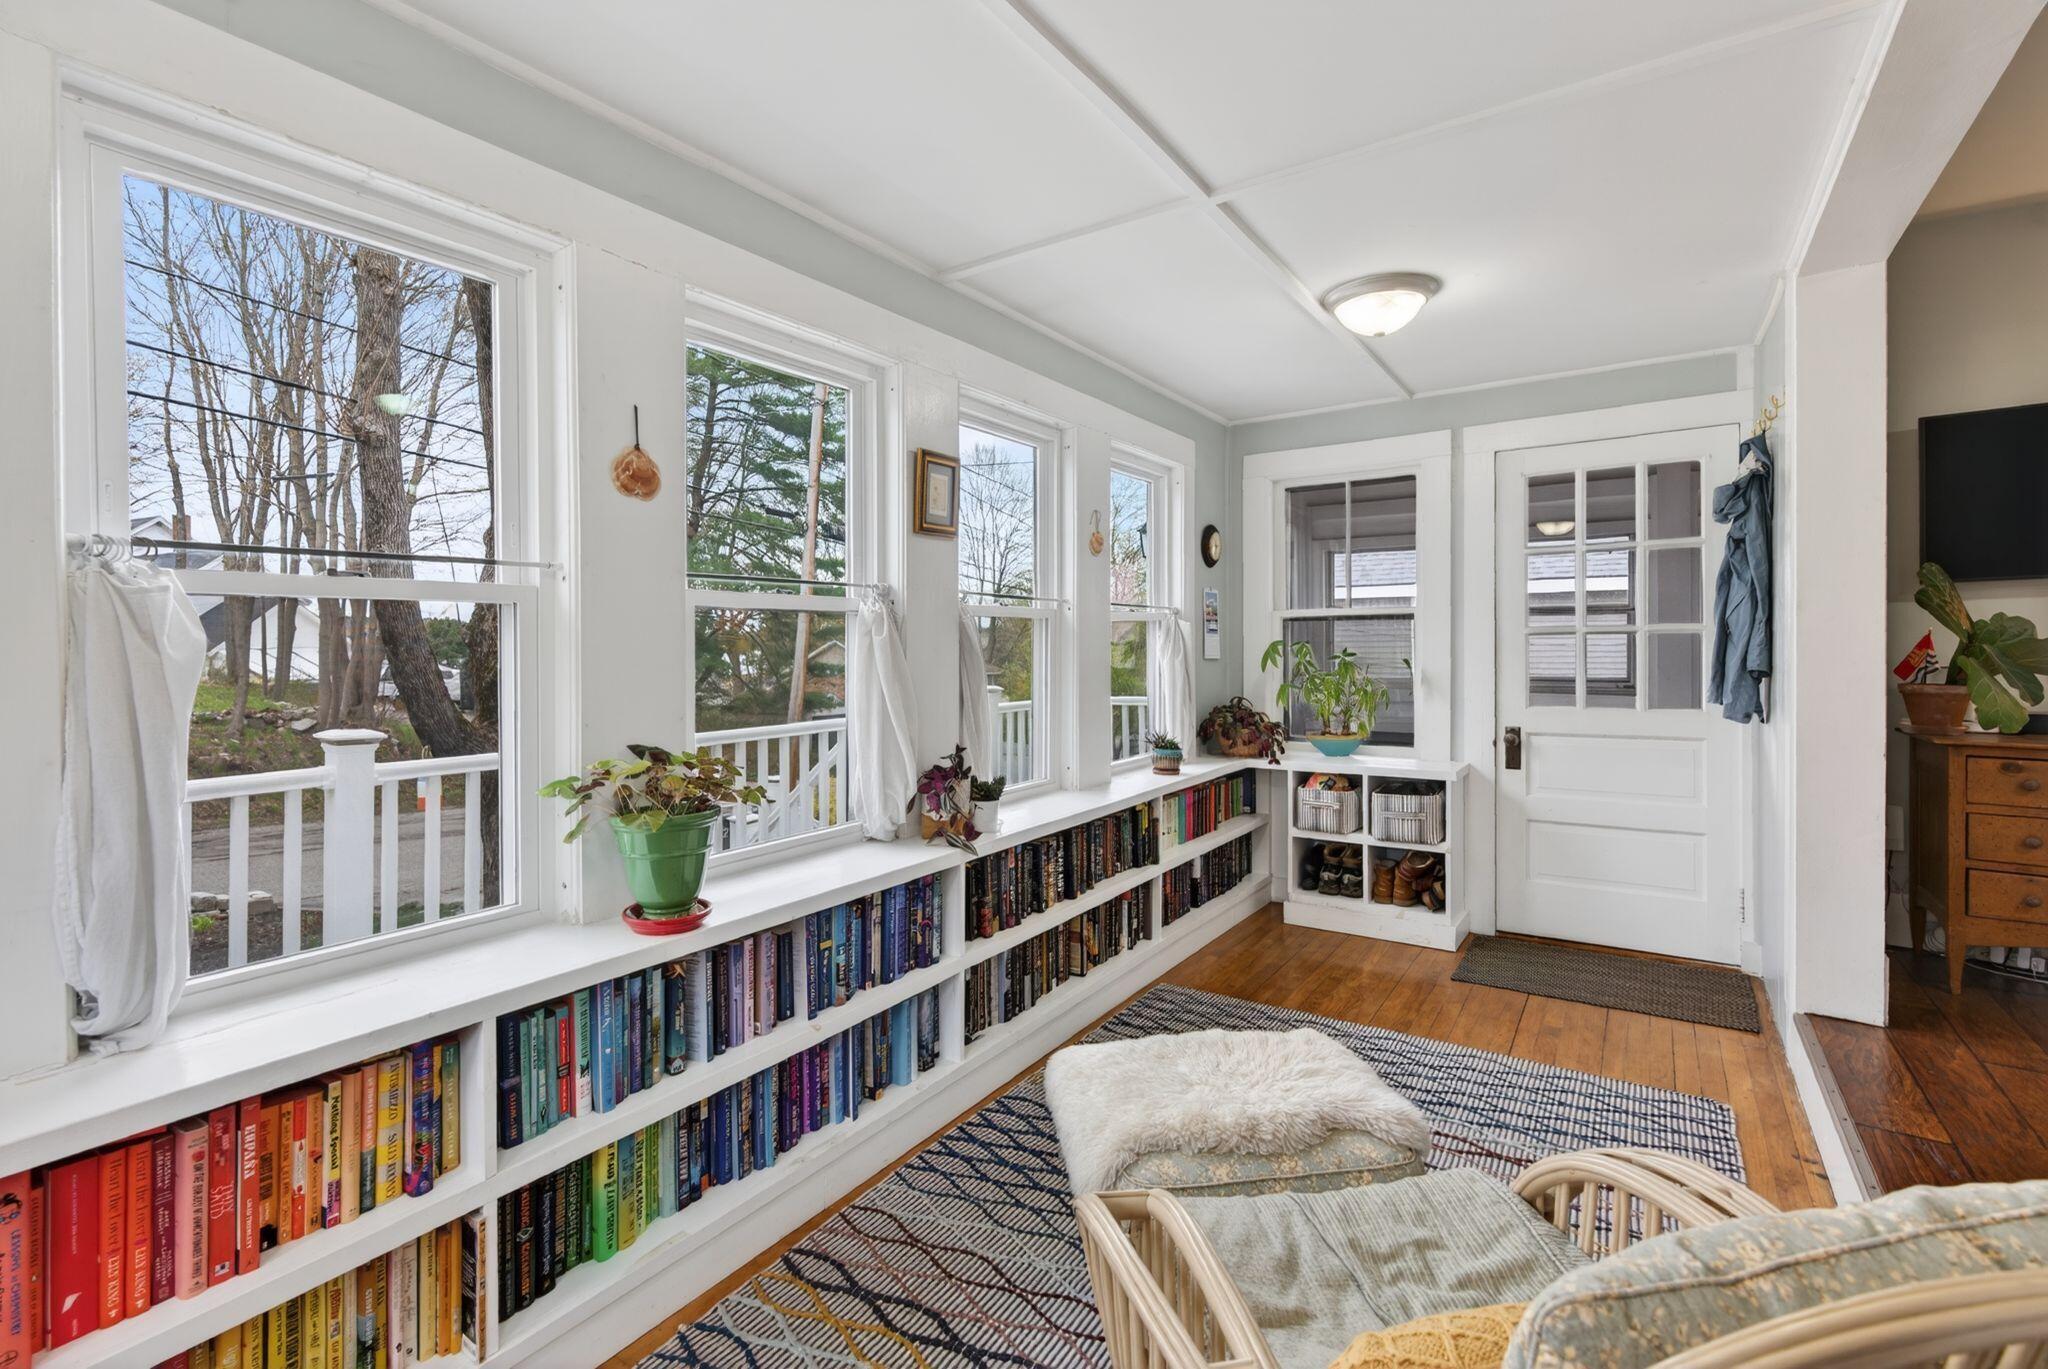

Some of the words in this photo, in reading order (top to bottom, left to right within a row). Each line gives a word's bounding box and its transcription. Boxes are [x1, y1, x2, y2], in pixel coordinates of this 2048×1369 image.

[329, 1095, 340, 1135] Nothing
[135, 1150, 151, 1181] Heart
[244, 1124, 259, 1179] ESPAÑA
[329, 1136, 340, 1170] Special
[107, 1158, 123, 1192] Heart
[107, 1194, 123, 1210] the
[136, 1187, 150, 1203] the
[109, 1214, 123, 1246] Lover
[136, 1205, 149, 1236] Lover
[107, 1255, 121, 1279] LILY
[134, 1247, 149, 1271] LILY
[106, 1281, 120, 1307] KING
[133, 1273, 147, 1296] KING
